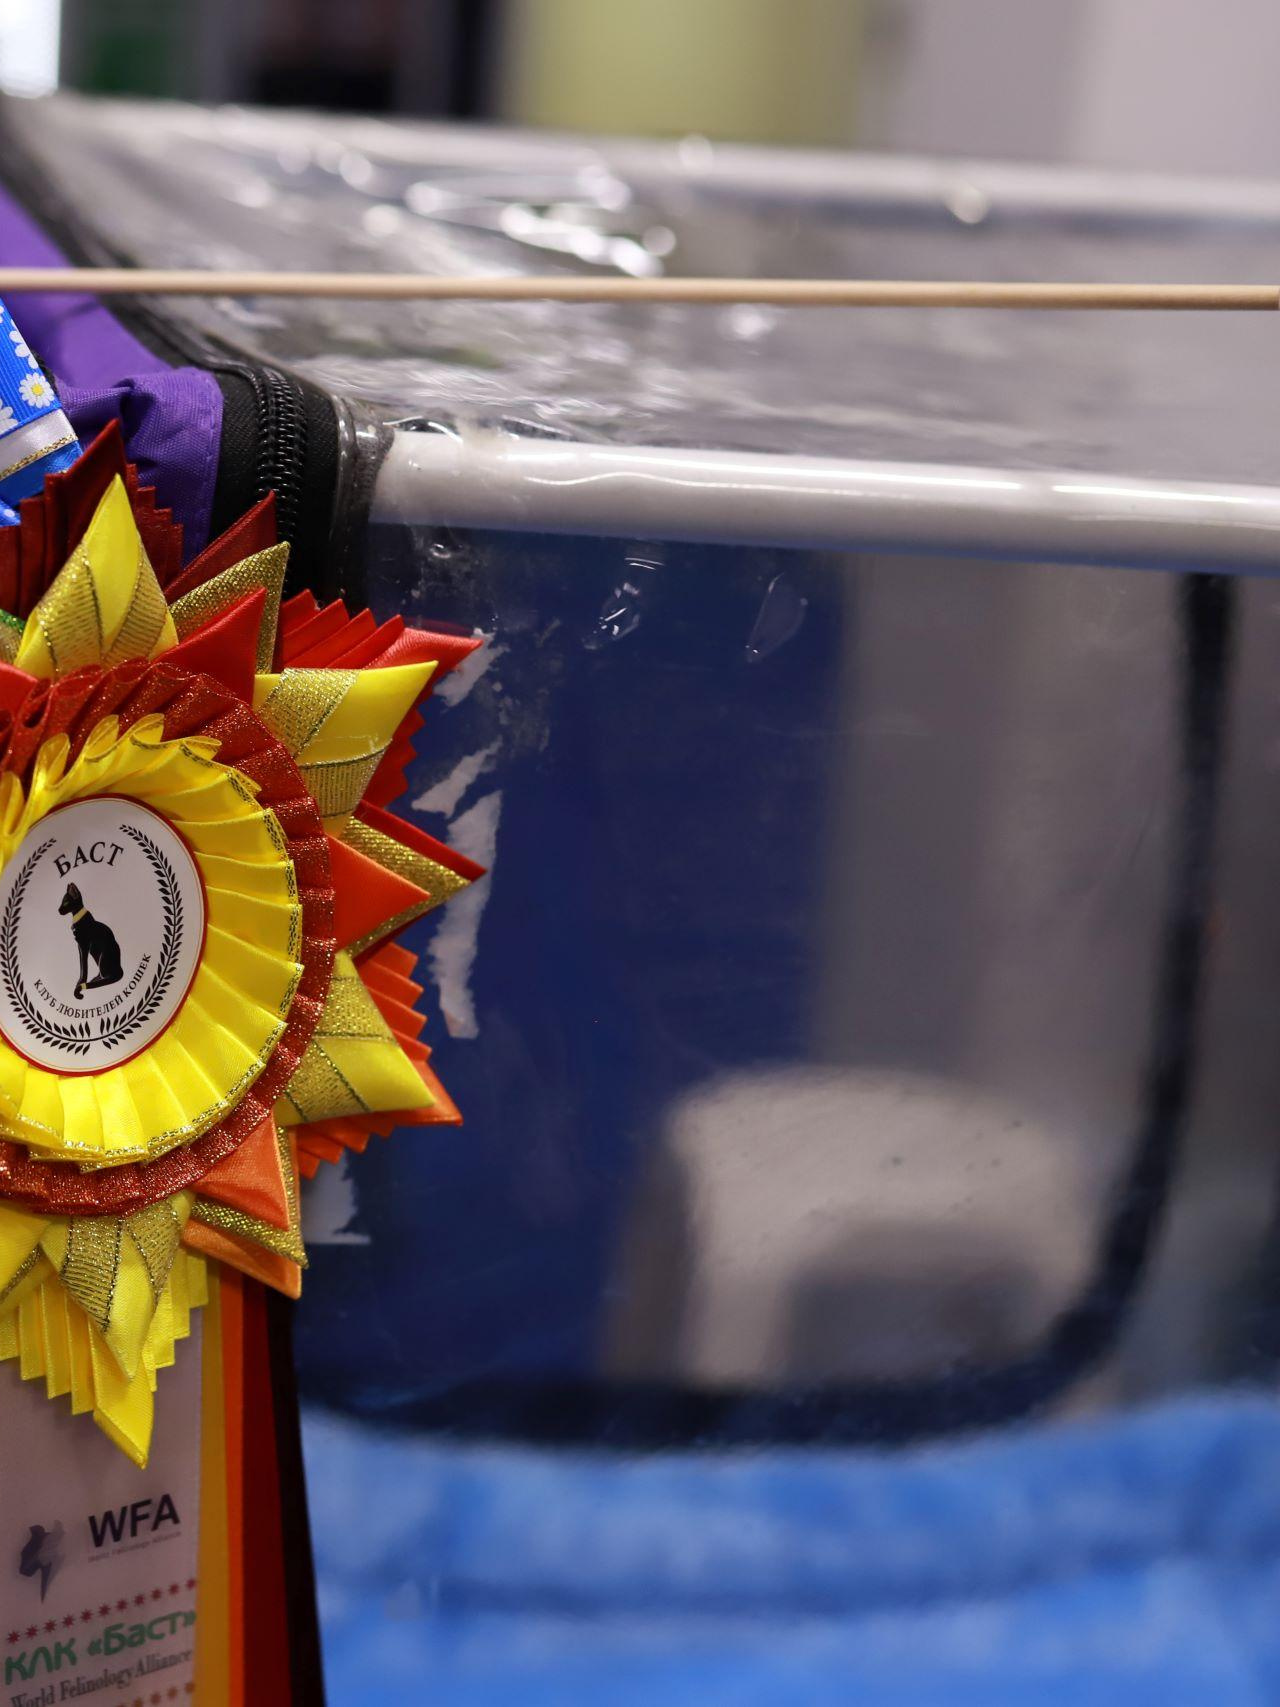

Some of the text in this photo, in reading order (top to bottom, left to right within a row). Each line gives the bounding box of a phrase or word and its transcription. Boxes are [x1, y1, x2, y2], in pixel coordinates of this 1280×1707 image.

[53, 841, 124, 878] БАСТ
[33, 953, 152, 1019] КЛУБ ЛЮБИТЕЛЕЙ КОШЕК
[87, 1492, 180, 1548] WFA
[5, 1638, 78, 1686] КЛК
[60, 1669, 134, 1702] Felinology
